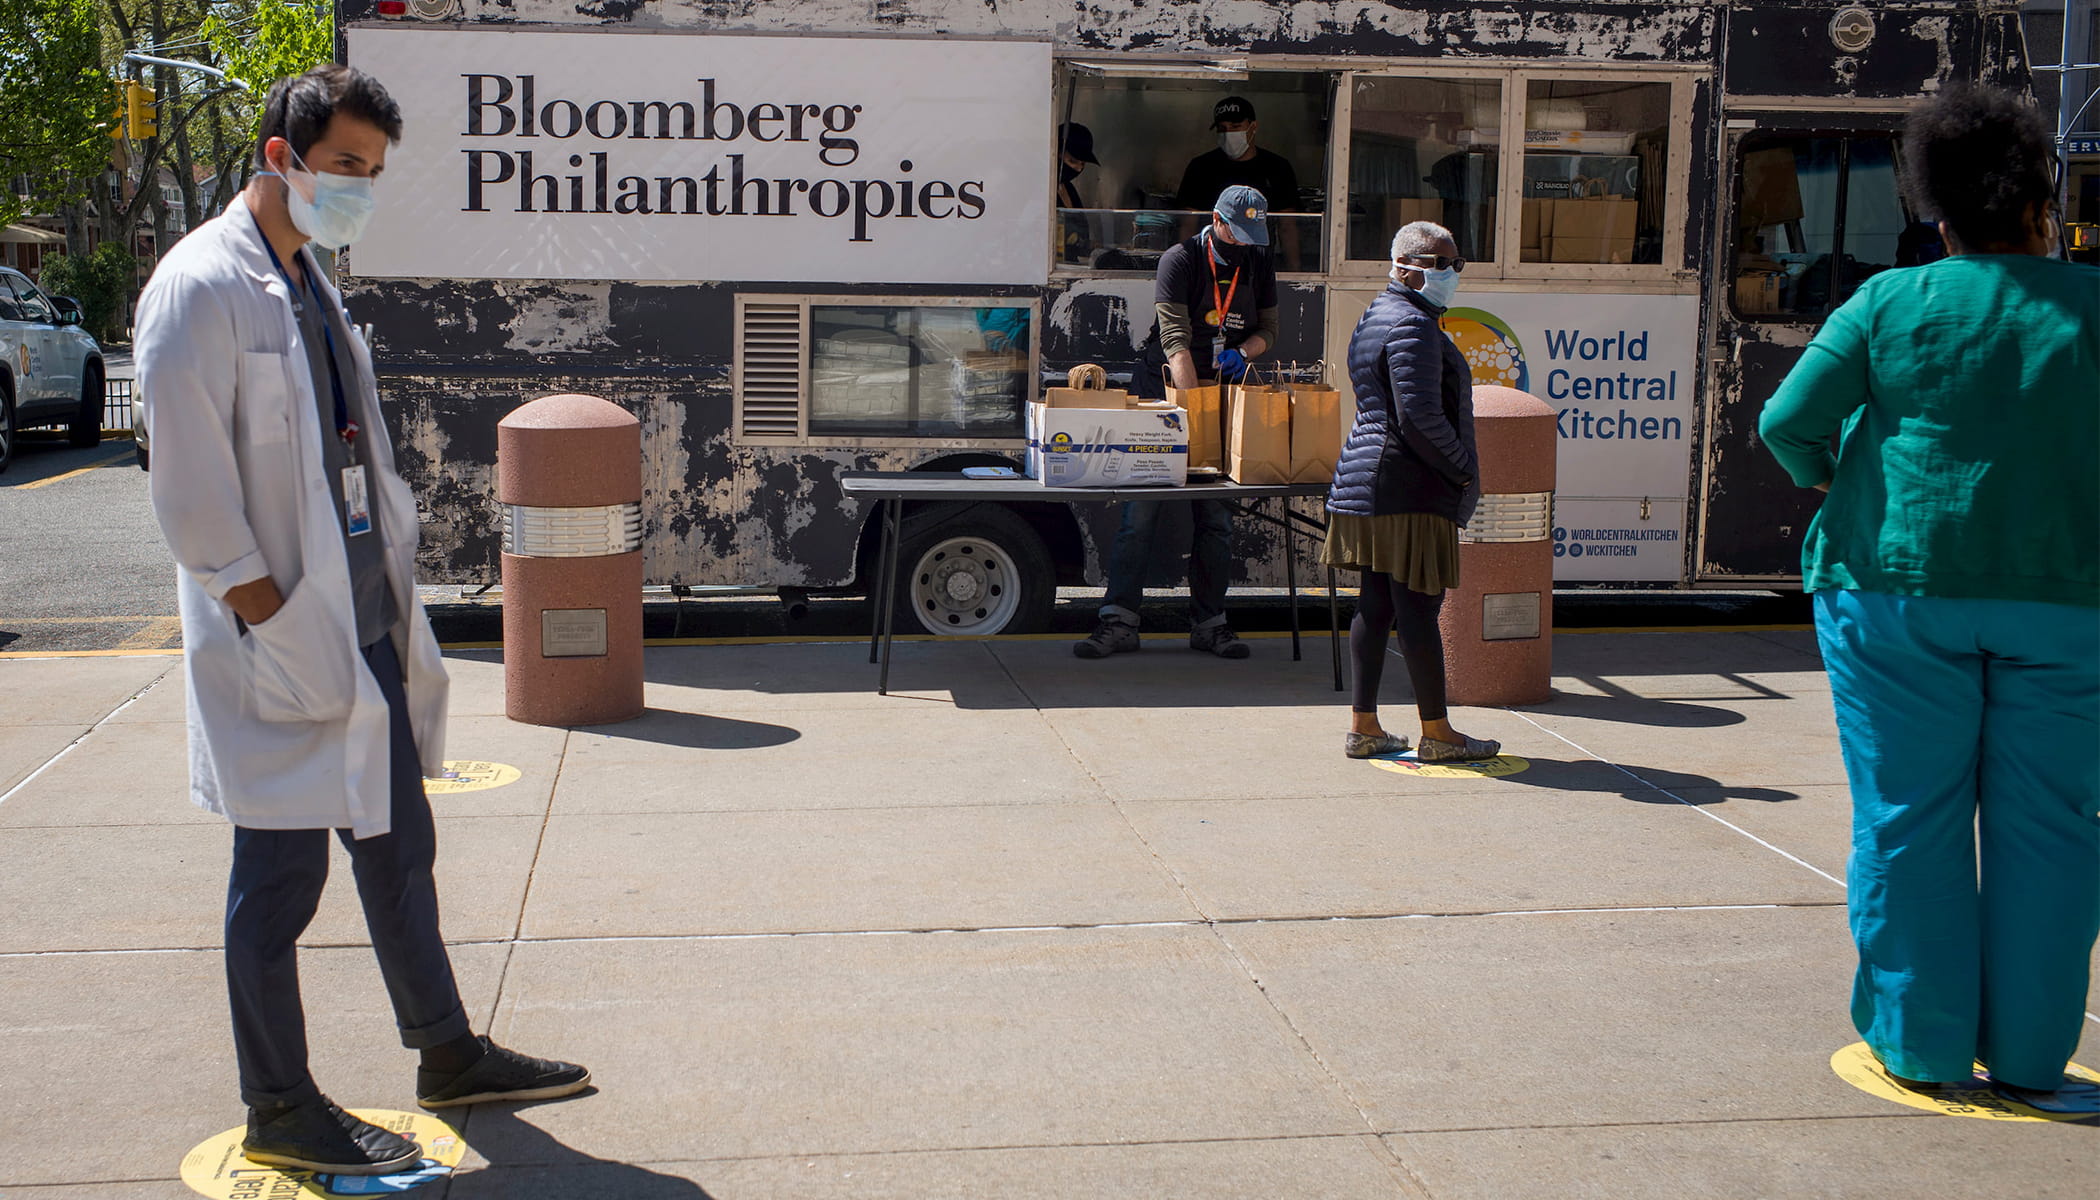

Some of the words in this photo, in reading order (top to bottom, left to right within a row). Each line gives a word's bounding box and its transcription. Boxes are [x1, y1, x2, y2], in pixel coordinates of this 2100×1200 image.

[461, 74, 863, 167] Bloomberg
[461, 149, 986, 242] Philanthropies
[1544, 329, 1649, 361] World
[1547, 368, 1677, 401] Central
[1128, 445, 1133, 453] 4
[1135, 445, 1159, 453] PIECE
[1571, 529, 1678, 541] WORLDCENTRALKITCHEN
[1586, 545, 1637, 556] WCKITCHEN
[267, 1174, 309, 1200] stan
